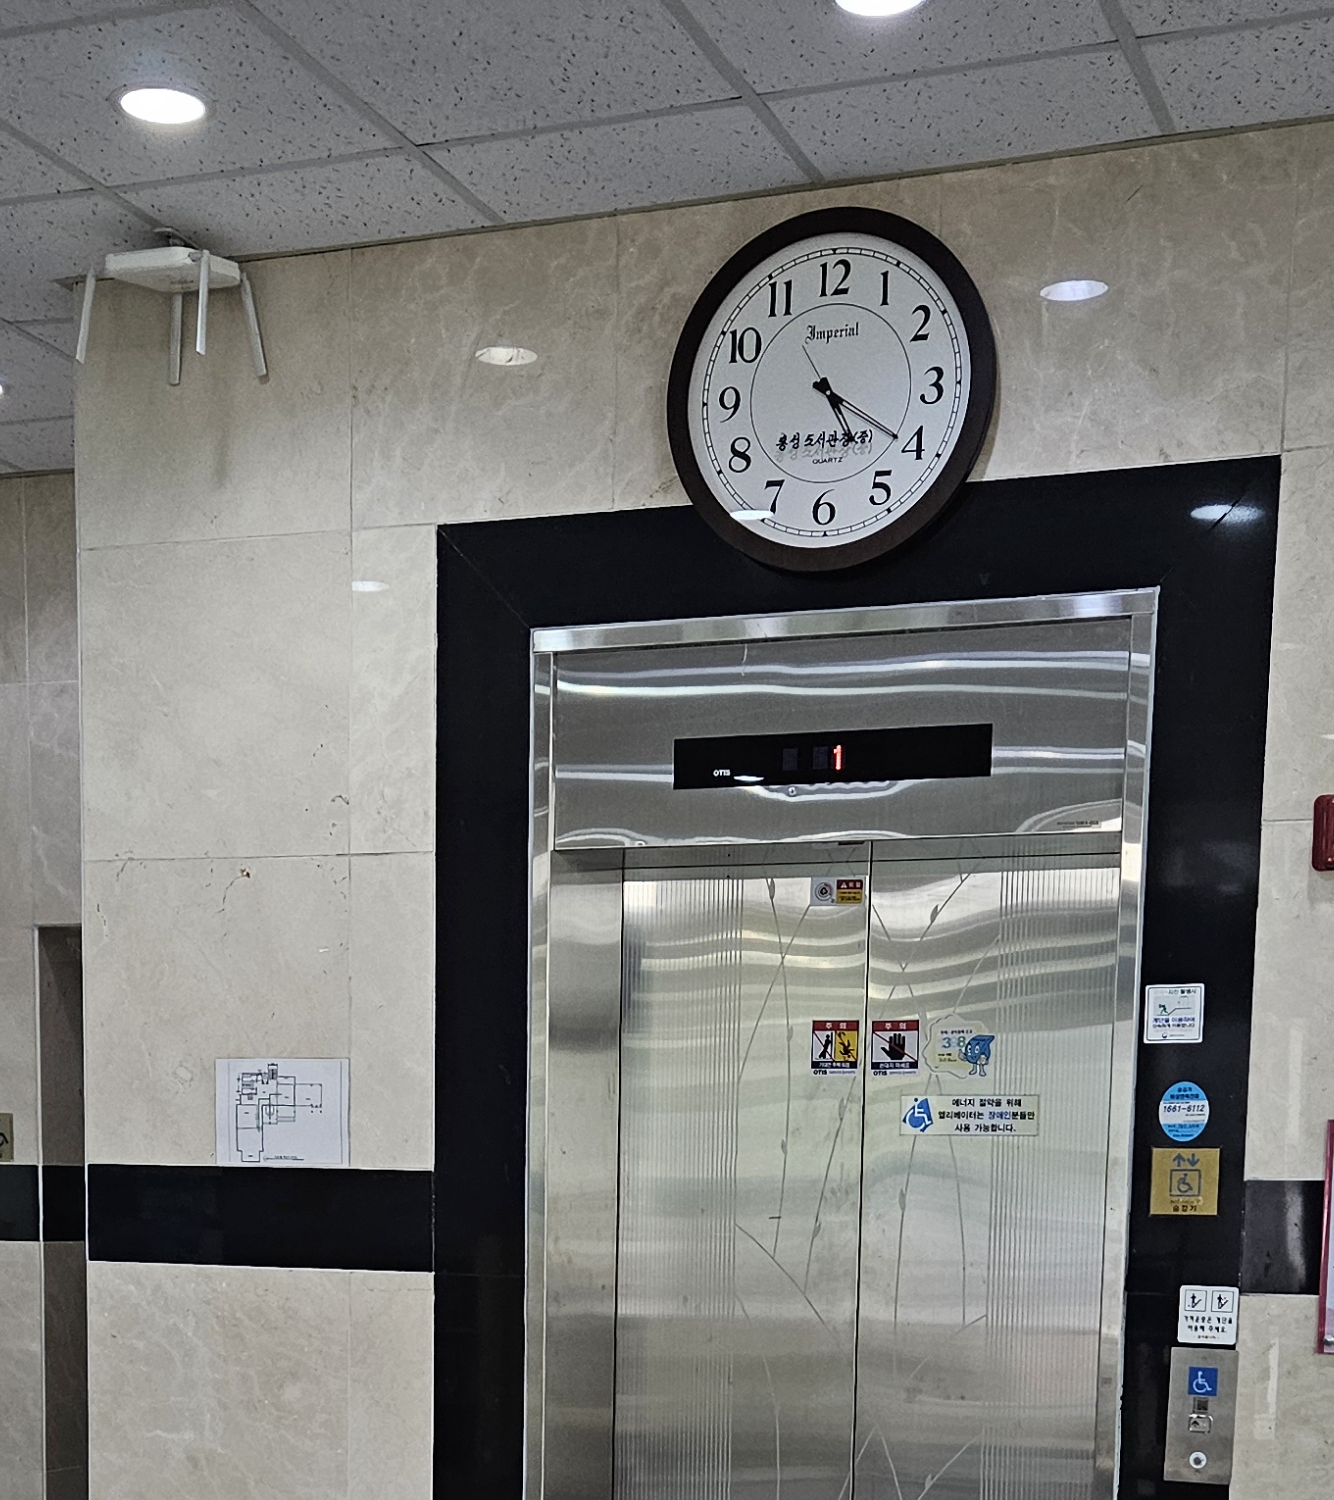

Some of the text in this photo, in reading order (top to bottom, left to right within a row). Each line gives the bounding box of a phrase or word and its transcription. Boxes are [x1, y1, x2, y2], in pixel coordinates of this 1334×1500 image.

[818, 259, 851, 297] 12
[880, 271, 889, 306] 1
[768, 279, 792, 318] 11
[805, 322, 859, 344] Imperial
[910, 304, 931, 342] 2
[729, 327, 762, 363] 10
[920, 367, 944, 404] 3
[719, 386, 741, 423] 9
[729, 437, 751, 473] 8
[901, 425, 925, 460] 4
[765, 479, 786, 514] 7
[869, 470, 892, 505] 5
[812, 489, 835, 525] 6
[834, 745, 842, 769] 1
[938, 1111, 1035, 1120] 엘리베이터는 장애인분들만
[952, 1098, 975, 1107] 에너지
[1006, 1098, 1022, 1107] 위해
[1163, 1104, 1205, 1113] 1661-6112
[955, 1123, 1016, 1132] 사용 가능합니다.
